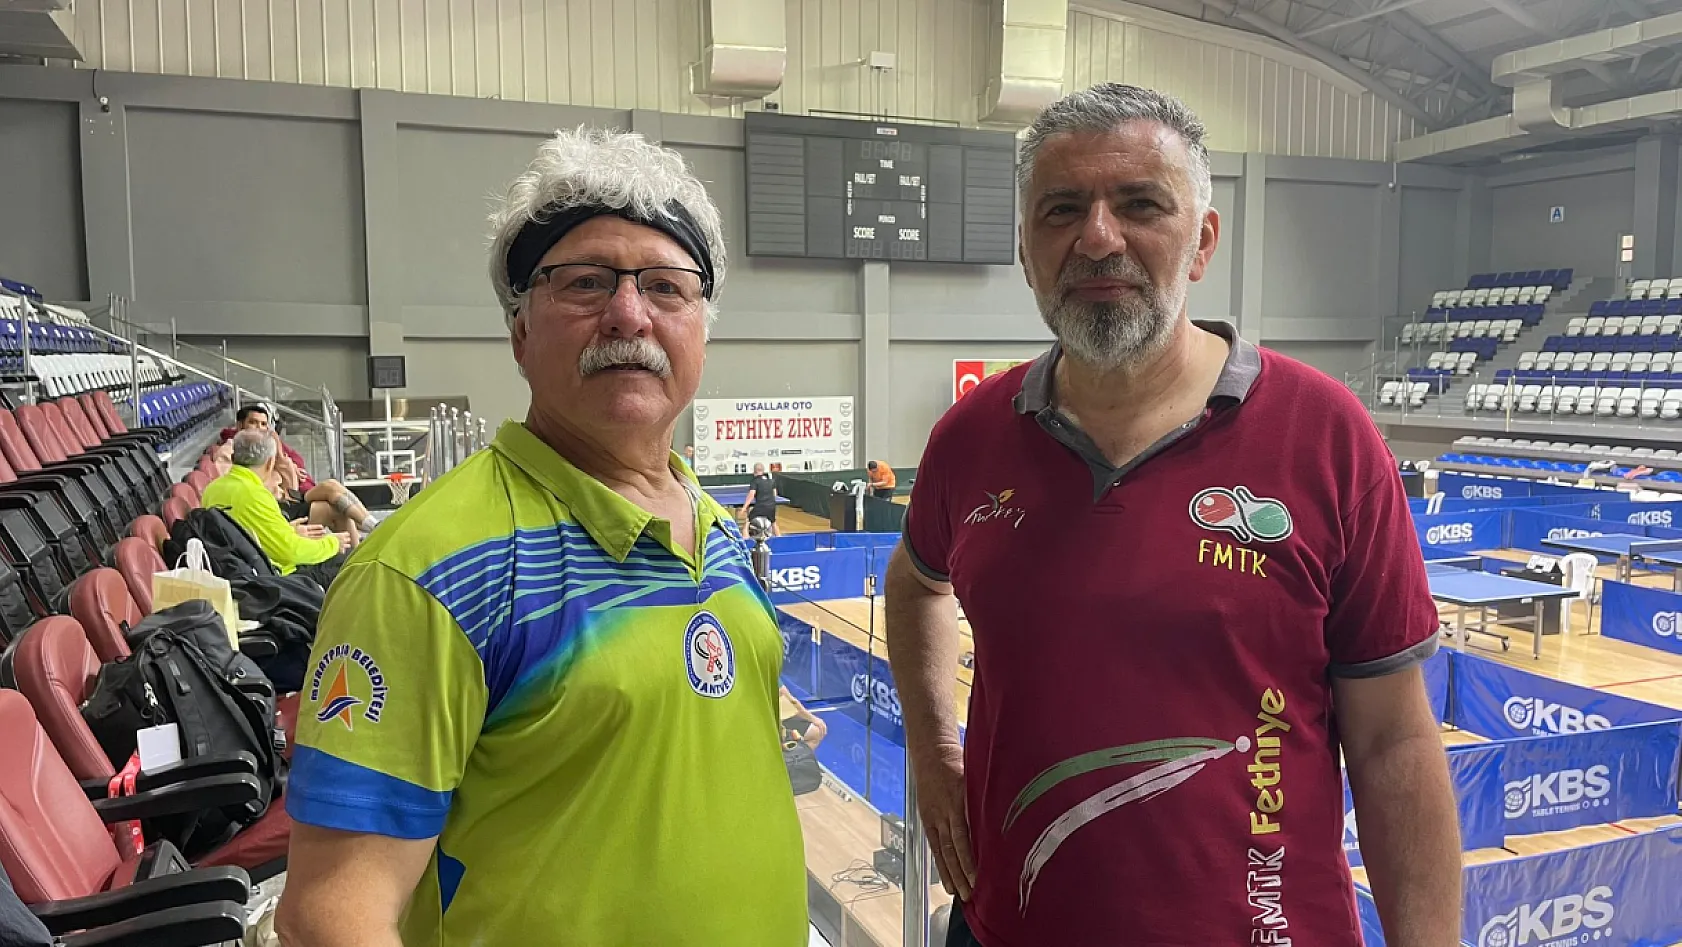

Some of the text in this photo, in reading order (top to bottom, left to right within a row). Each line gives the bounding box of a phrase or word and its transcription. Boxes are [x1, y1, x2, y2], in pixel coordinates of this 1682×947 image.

[1552, 207, 1561, 218] A
[853, 226, 875, 240] SCORE
[899, 228, 920, 241] SCORE
[736, 401, 812, 411] UYSALLAR OTO
[715, 413, 833, 440] FETHİYE ZİRVE
[1473, 485, 1502, 499] KBS
[1641, 510, 1672, 526] KBS
[1440, 522, 1473, 539] KBS
[1197, 539, 1267, 578] FMTK
[773, 565, 821, 586] KBS
[1247, 687, 1292, 835] Fethiye
[1532, 764, 1611, 807] KBS
[1517, 885, 1614, 946] KBS
